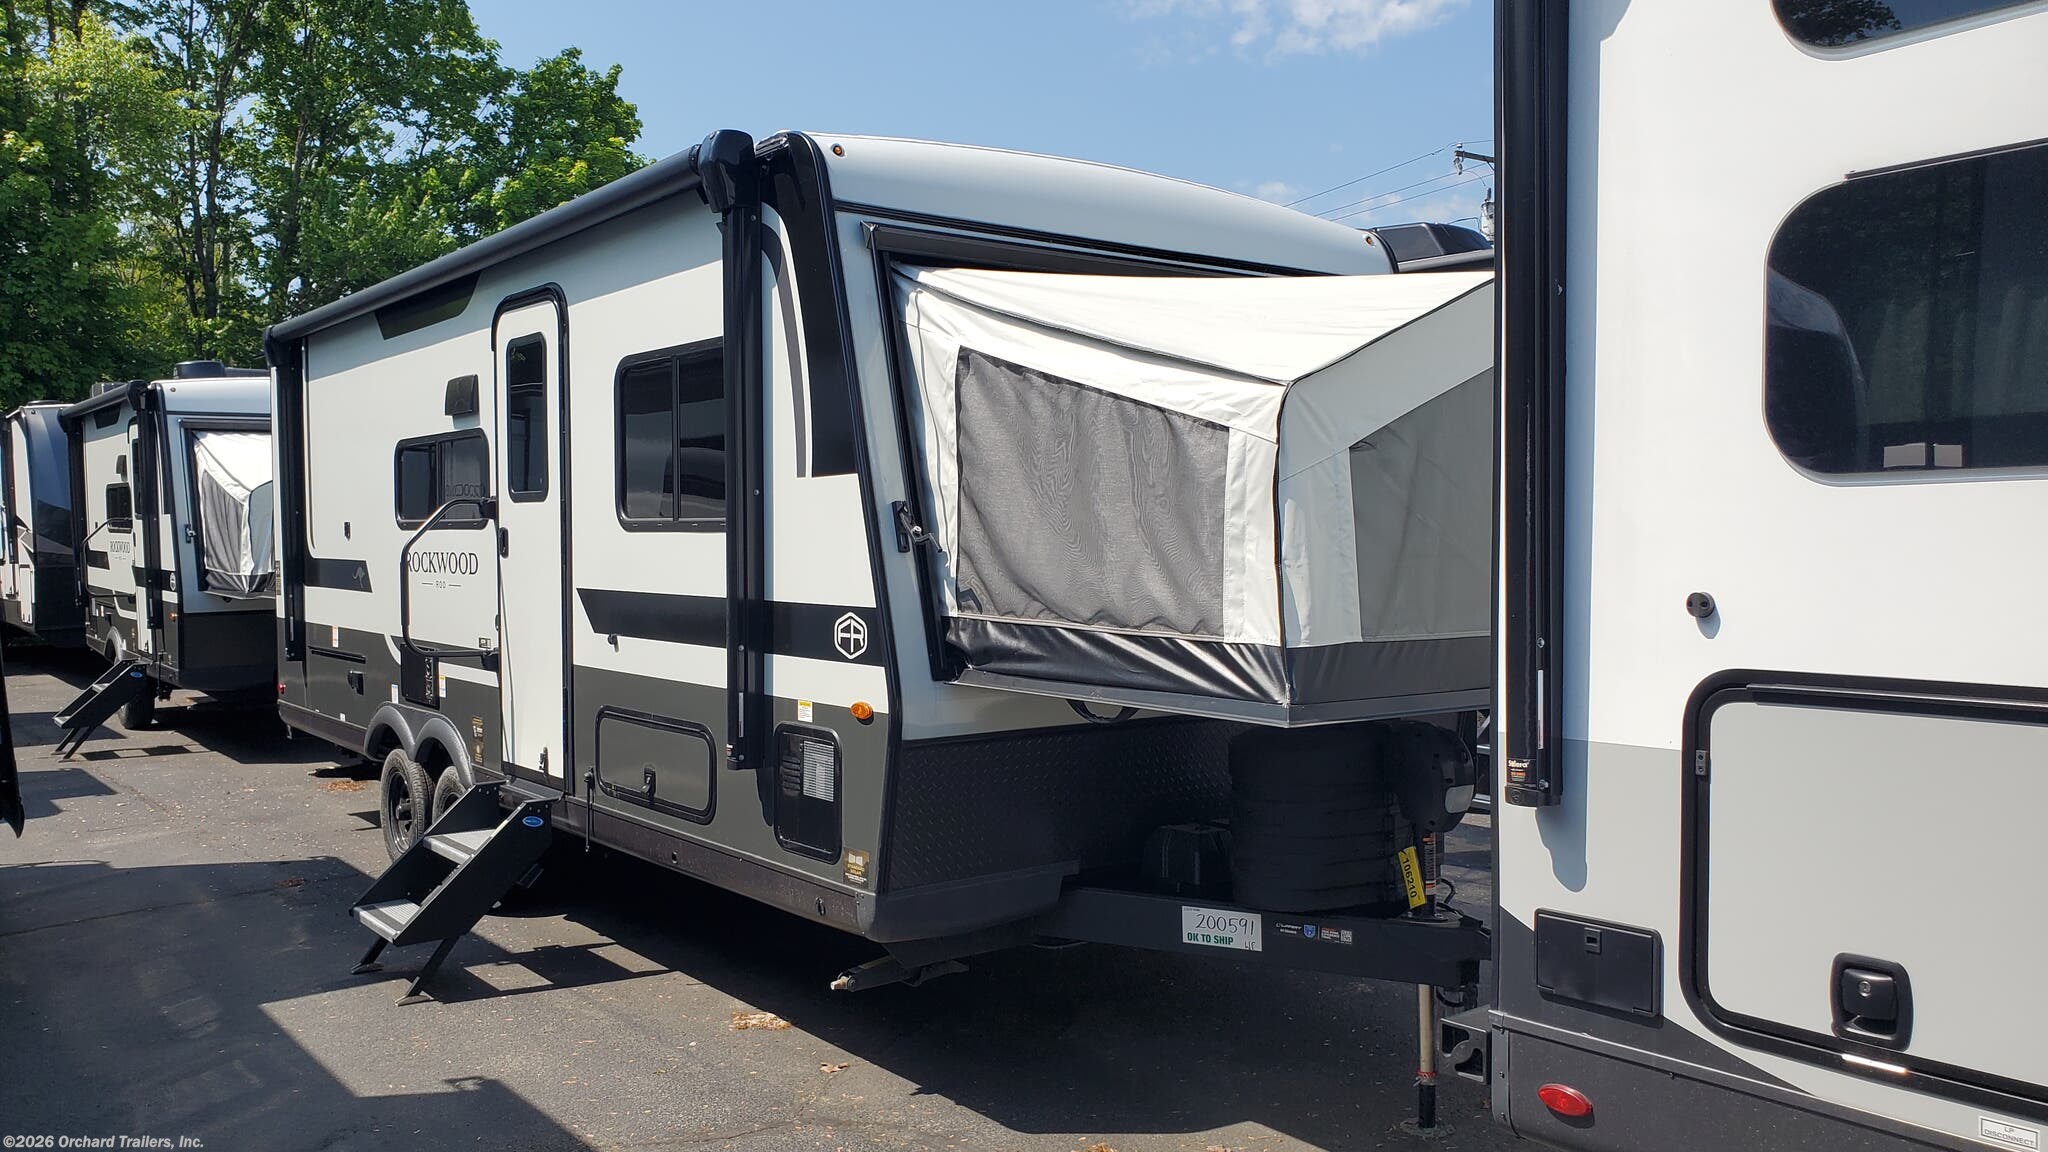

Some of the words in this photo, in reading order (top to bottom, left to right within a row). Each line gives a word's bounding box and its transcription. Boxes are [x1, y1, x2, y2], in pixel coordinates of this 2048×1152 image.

[407, 551, 479, 575] ROCKWOOD
[1402, 858, 1418, 898] 106210
[1195, 913, 1254, 936] 200591
[1187, 932, 1199, 942] OK
[1200, 933, 1212, 943] TO
[1214, 935, 1234, 945] SHIP
[1984, 1129, 2035, 1146] DISCONNECT
